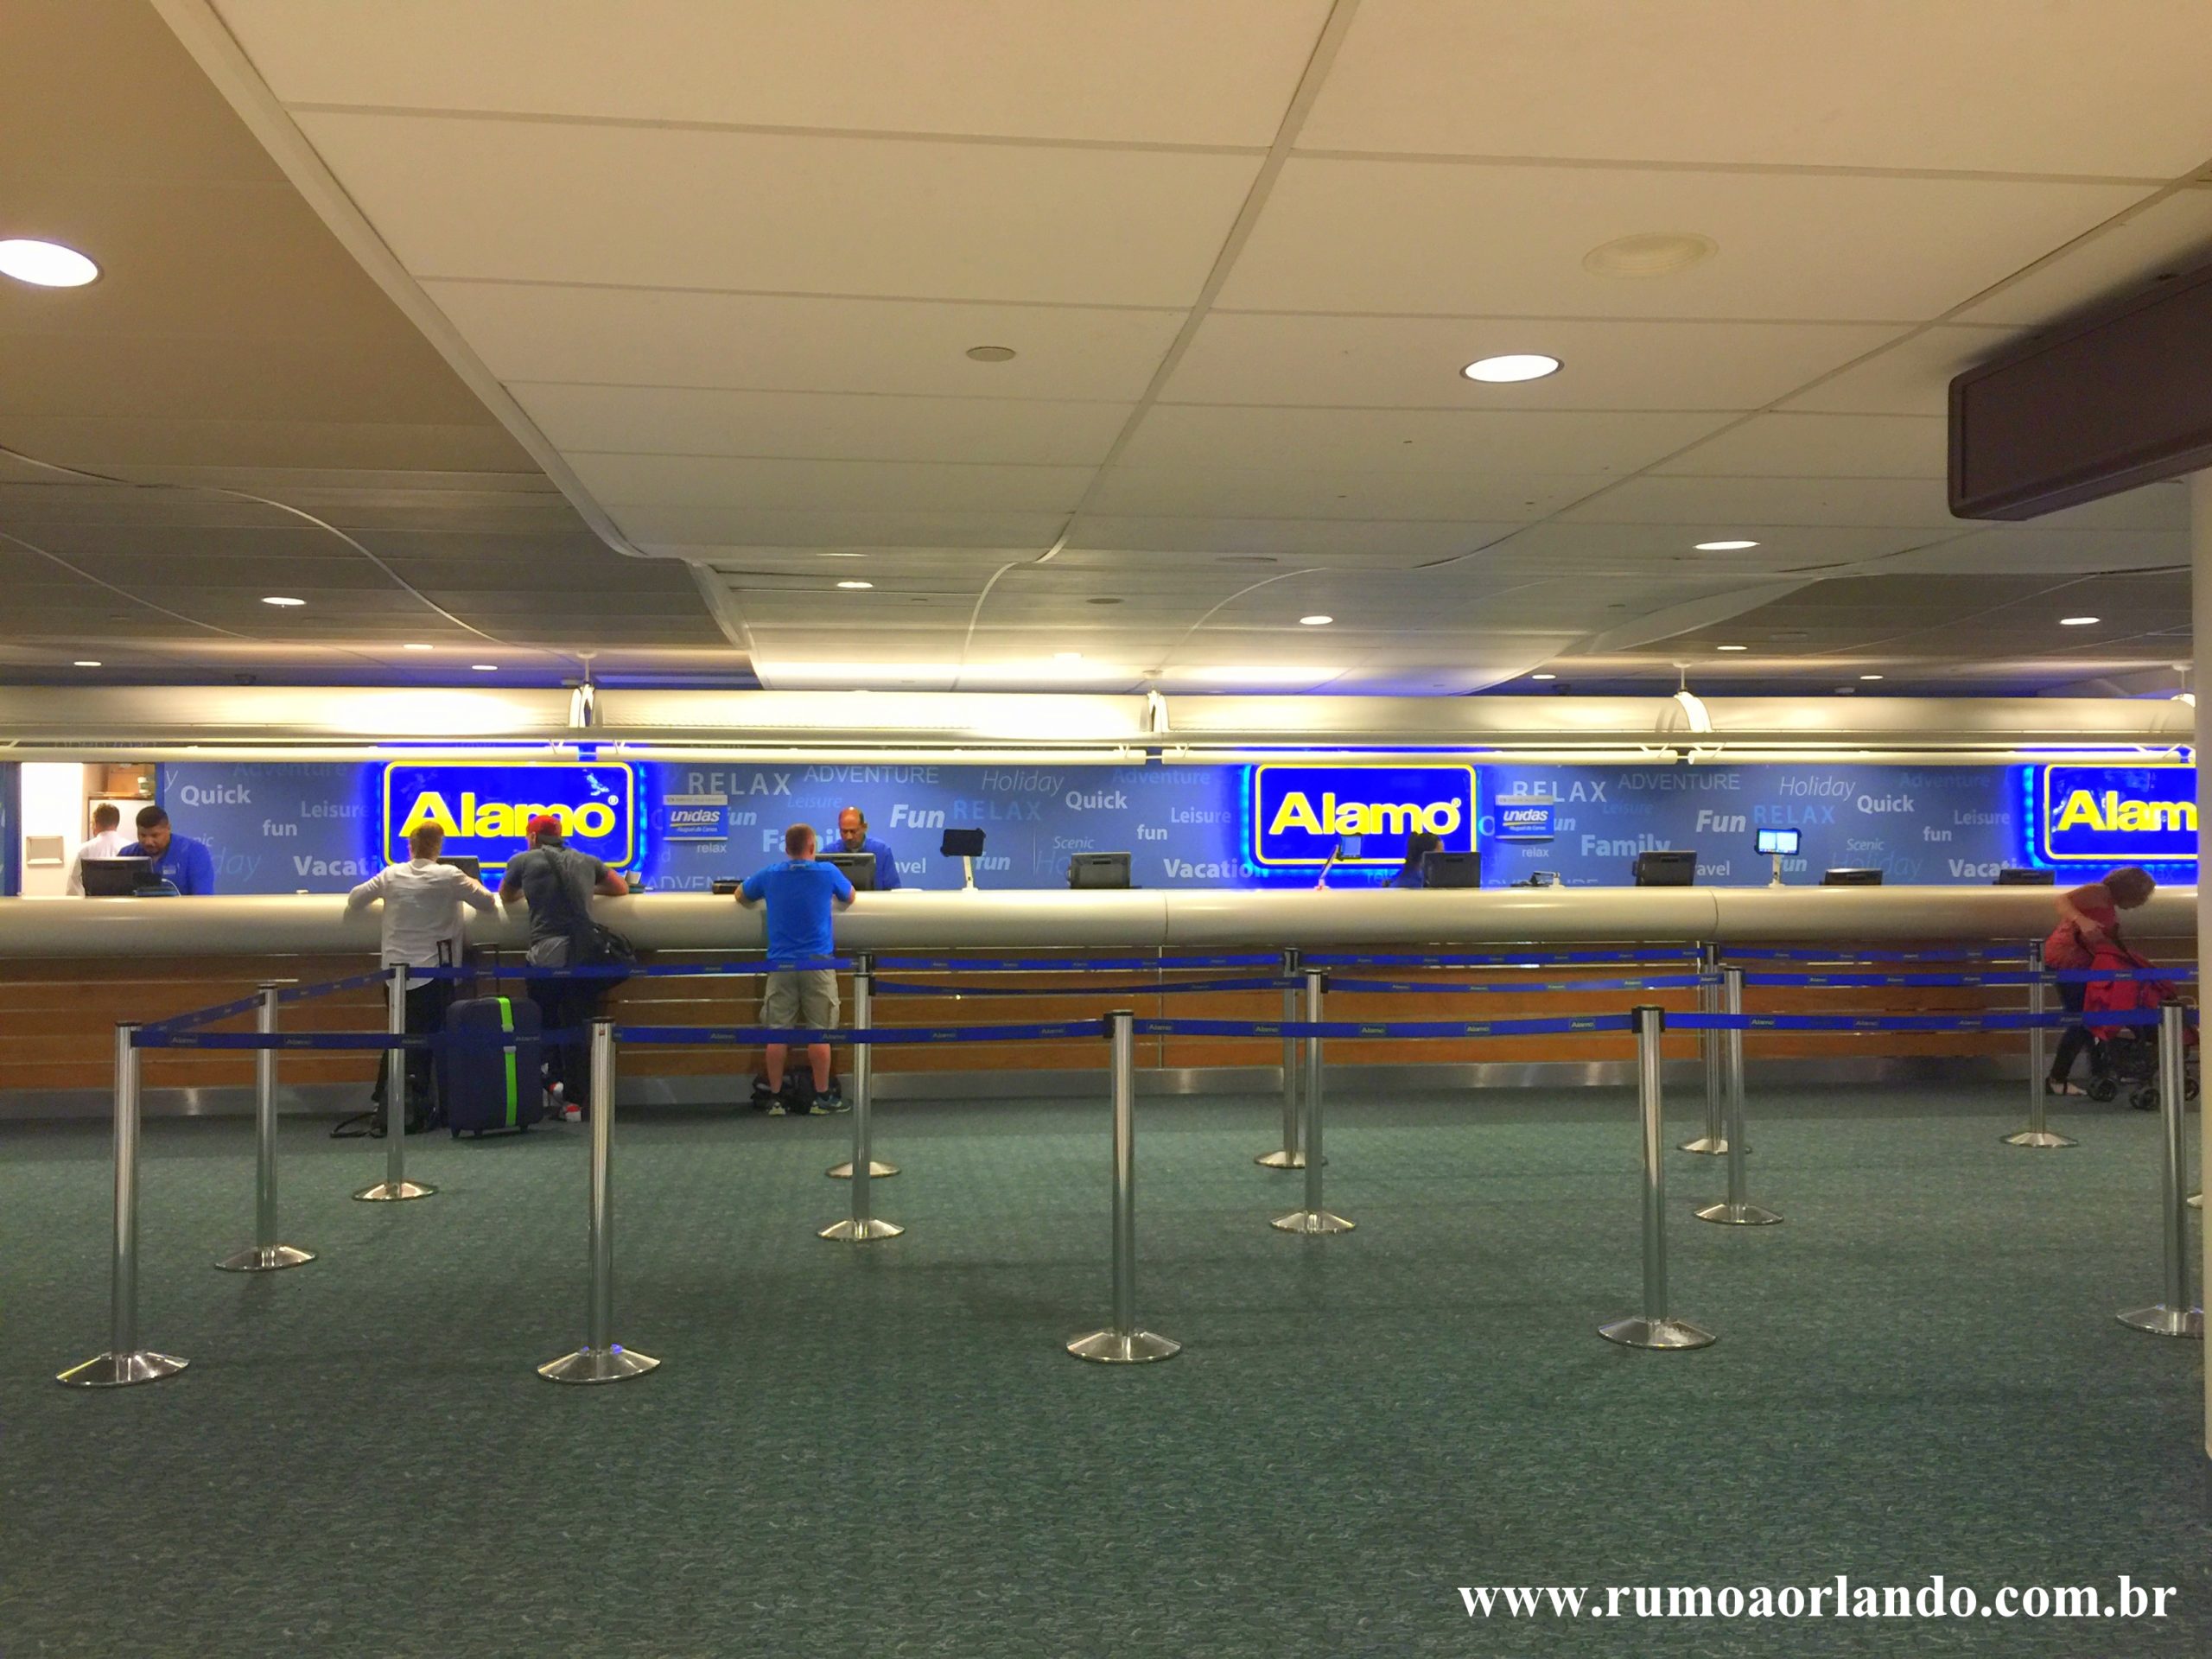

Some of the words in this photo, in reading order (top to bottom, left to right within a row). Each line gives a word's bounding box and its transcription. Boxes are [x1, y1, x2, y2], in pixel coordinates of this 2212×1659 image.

[688, 772, 791, 796] RELAX
[804, 766, 939, 784] ADVENTURE
[981, 770, 1065, 798] Holiday
[1113, 768, 1211, 785] Adventure
[1618, 773, 1741, 791] ADVENTURE
[1899, 772, 1990, 787] Adventure
[181, 784, 251, 807] Quick
[1512, 780, 1607, 803] RELAX
[1779, 776, 1856, 802] Holiday
[301, 800, 370, 818] Leisure
[788, 795, 842, 809] Leisure
[1065, 791, 1128, 810] Quick
[1603, 802, 1655, 816] Leisure
[1857, 794, 1915, 814] Quick
[398, 791, 616, 838] Alamo
[671, 810, 721, 823] unidas
[889, 804, 946, 829] Fun
[952, 799, 1041, 821] RELAX
[1171, 806, 1231, 823] Leisure
[1268, 791, 1461, 836] Alamo
[1503, 809, 1549, 822] unidas
[1752, 805, 1836, 824] RELAX
[1954, 809, 2011, 825] Leisure
[2056, 790, 2198, 831] Alam
[262, 819, 297, 836] fun
[1554, 817, 1577, 831] un
[1695, 810, 1746, 833] Fun
[1137, 823, 1167, 840] fun
[1923, 826, 1952, 842] fun
[696, 842, 728, 854] relax
[1052, 836, 1096, 849] Scenic
[1846, 837, 1885, 851] Scenic
[975, 851, 1011, 871] fun
[1522, 847, 1549, 858] relax
[292, 855, 378, 876] Vacati
[1696, 860, 1730, 876] avel
[1780, 855, 1808, 872] un
